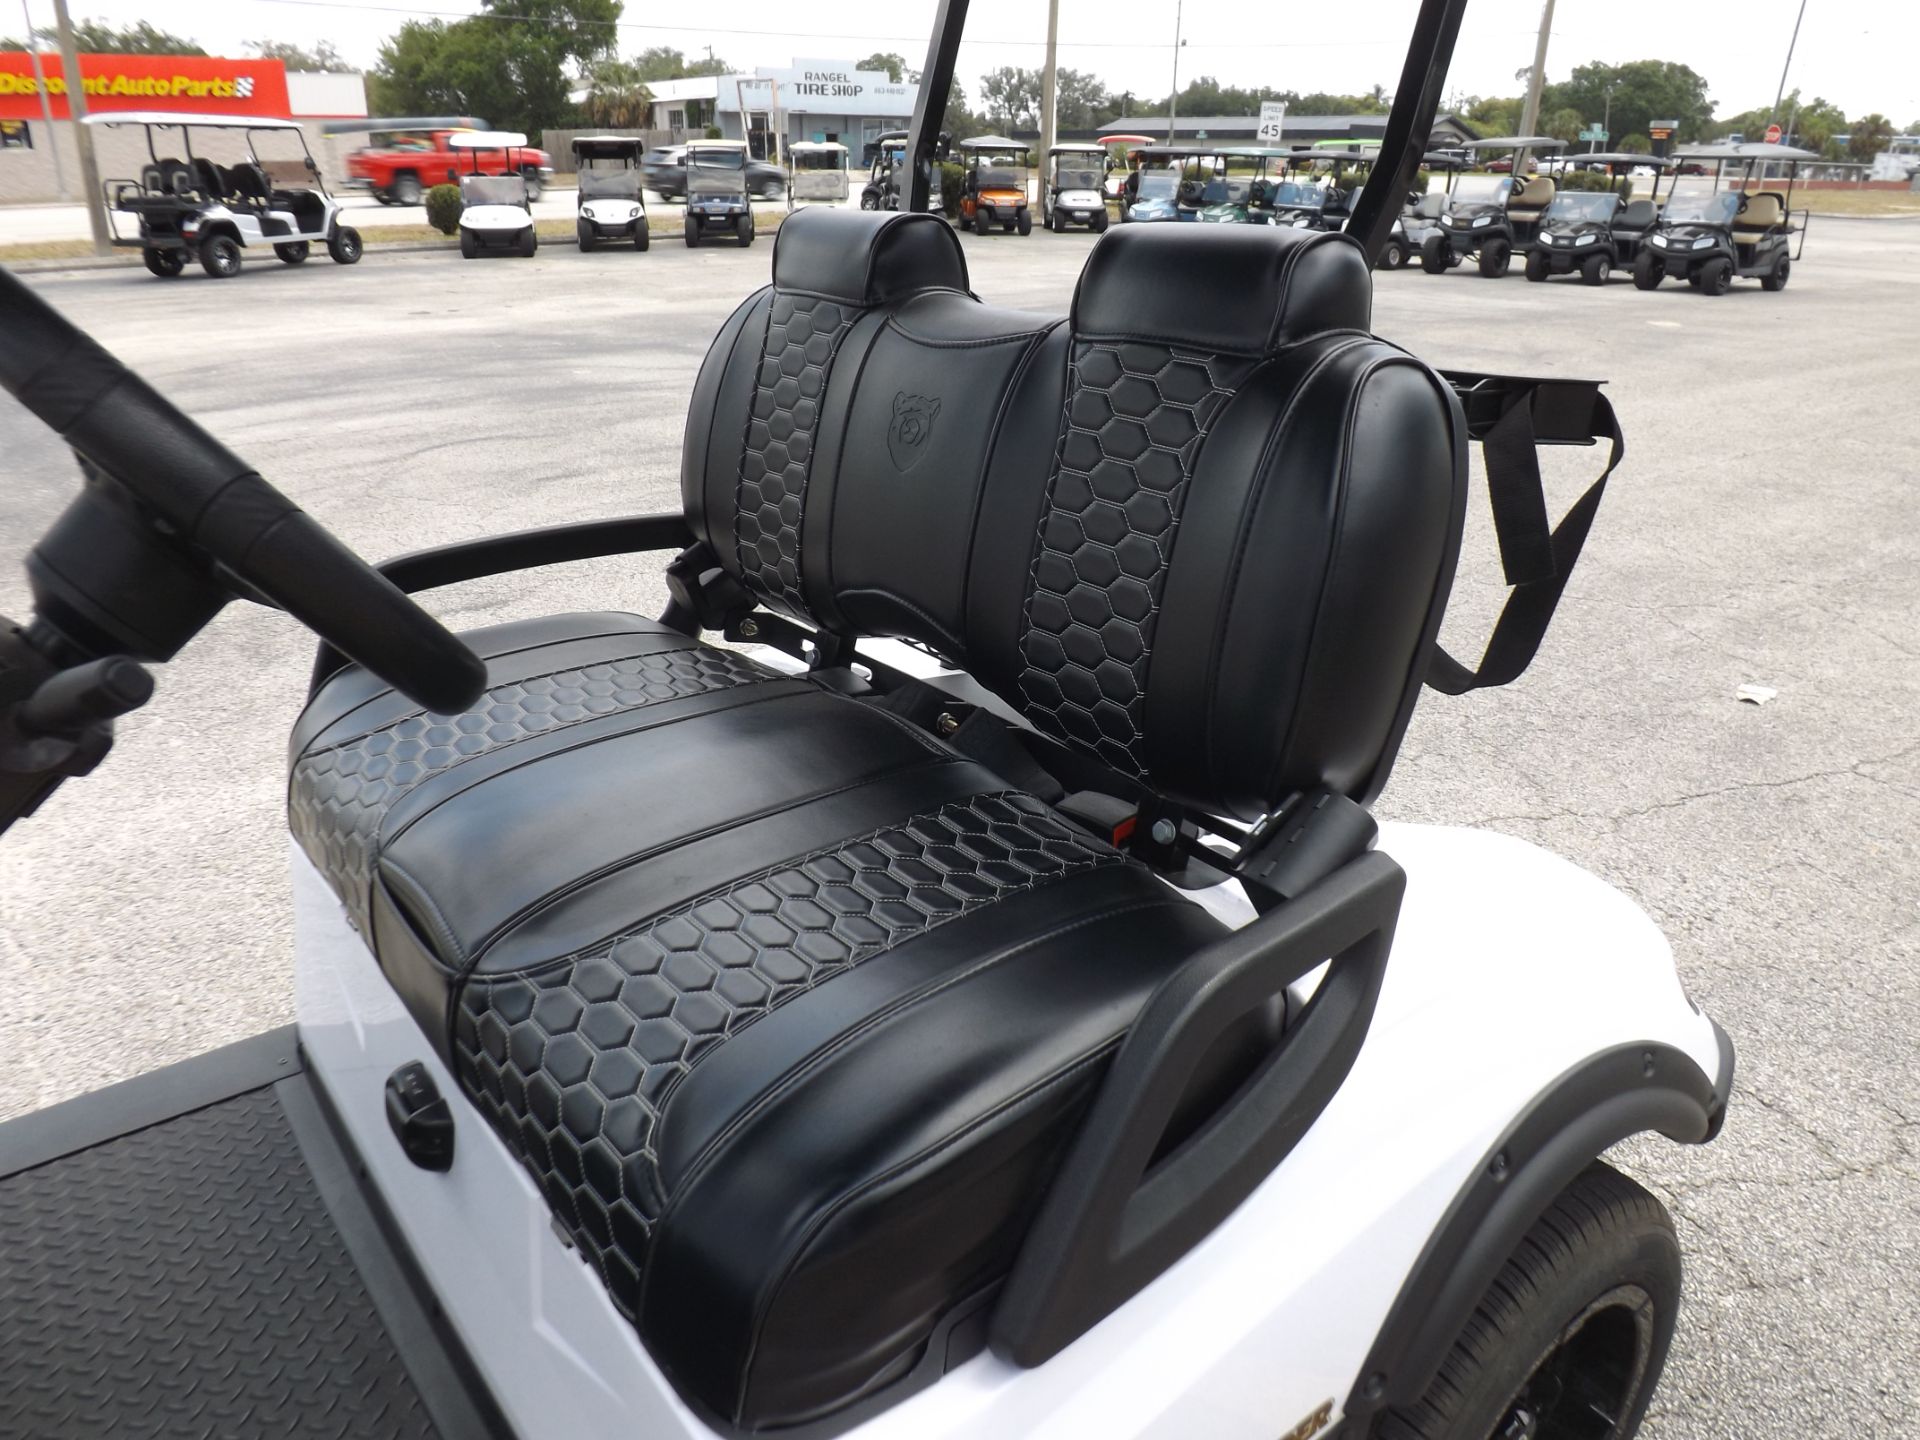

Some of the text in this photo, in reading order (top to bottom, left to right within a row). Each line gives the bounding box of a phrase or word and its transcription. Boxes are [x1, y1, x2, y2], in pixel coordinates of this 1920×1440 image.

[804, 71, 851, 83] RANGEL
[108, 74, 170, 96] Auto
[170, 75, 234, 97] Parts
[794, 82, 829, 96] TIRE
[831, 84, 864, 97] SHOP
[1260, 124, 1279, 137] 45
